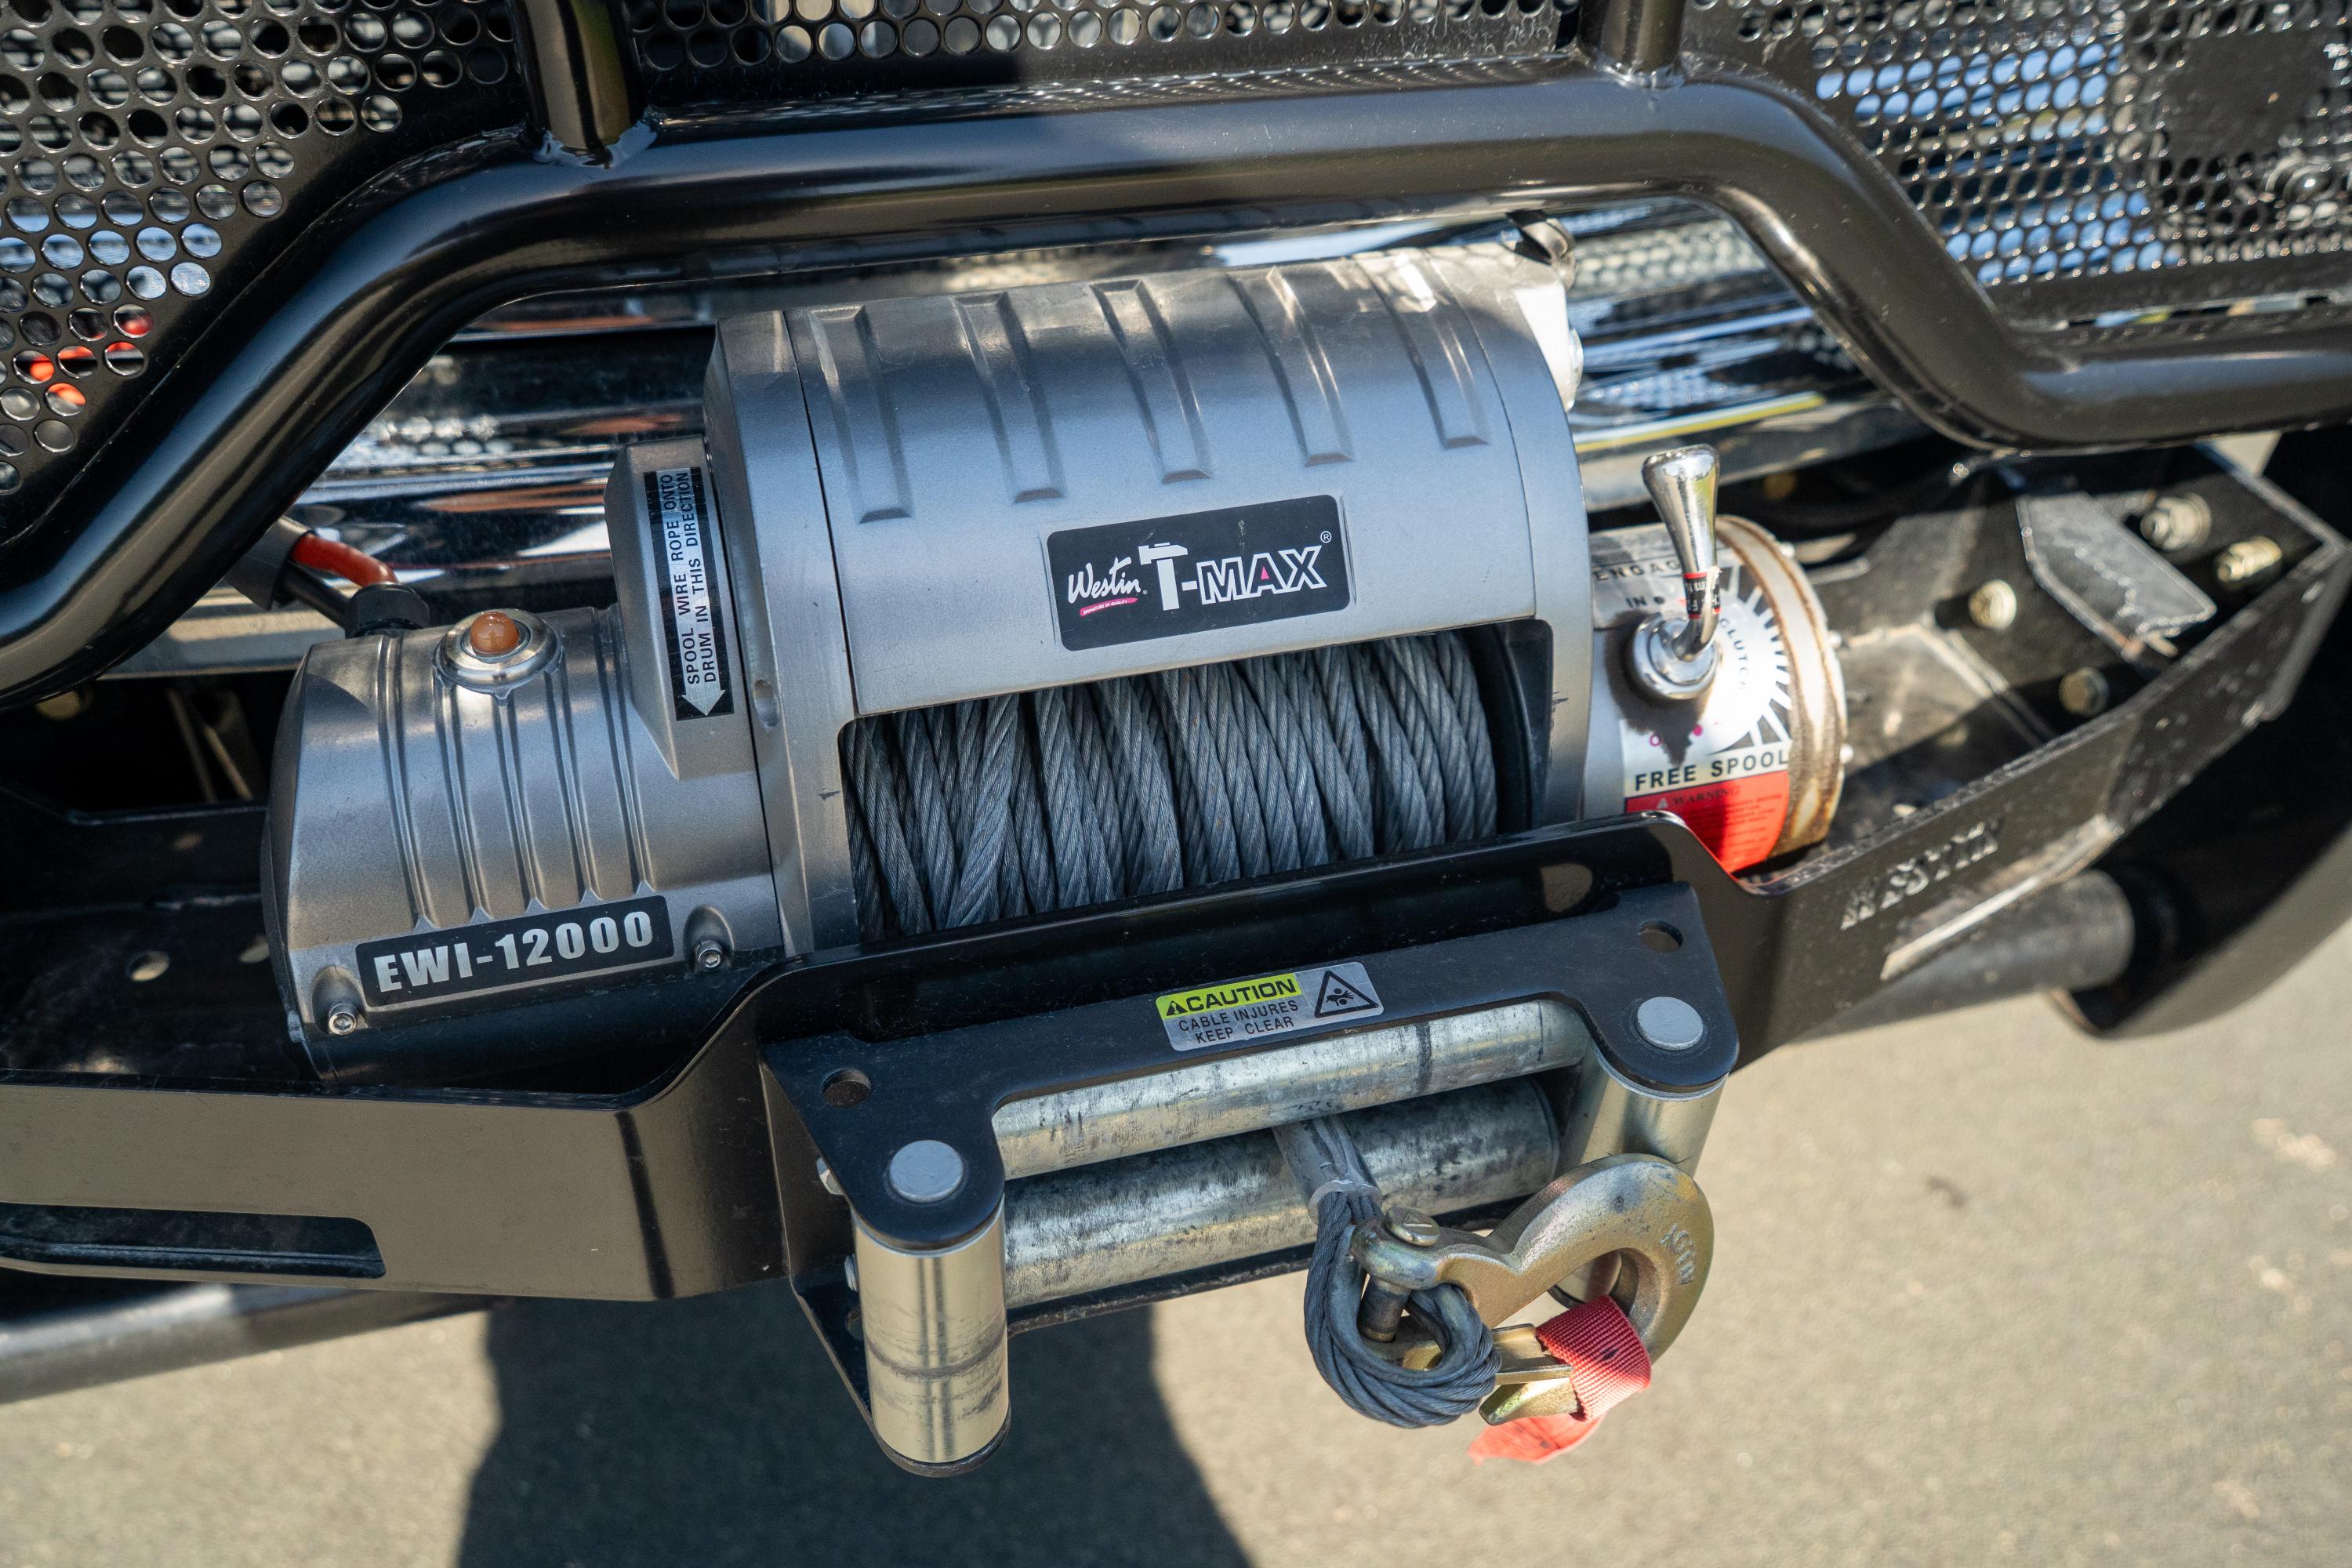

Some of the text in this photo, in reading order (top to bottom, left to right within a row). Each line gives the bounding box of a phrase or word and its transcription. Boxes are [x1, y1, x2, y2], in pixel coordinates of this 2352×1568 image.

[660, 474, 700, 685] SPOOL WIRE ROPE ONTO
[676, 472, 717, 683] DRUM IN THIS DIRECTION
[1593, 559, 1681, 581] ENGAG
[1083, 604, 1105, 615] SIGNATURE
[1635, 749, 1788, 791] FREE SPOOL
[373, 910, 653, 993] EWI-12000
[1185, 978, 1298, 1012] CAUTION
[1178, 1000, 1299, 1032] CABLE INJURES
[1194, 1016, 1294, 1044] KEEP CLEAR
